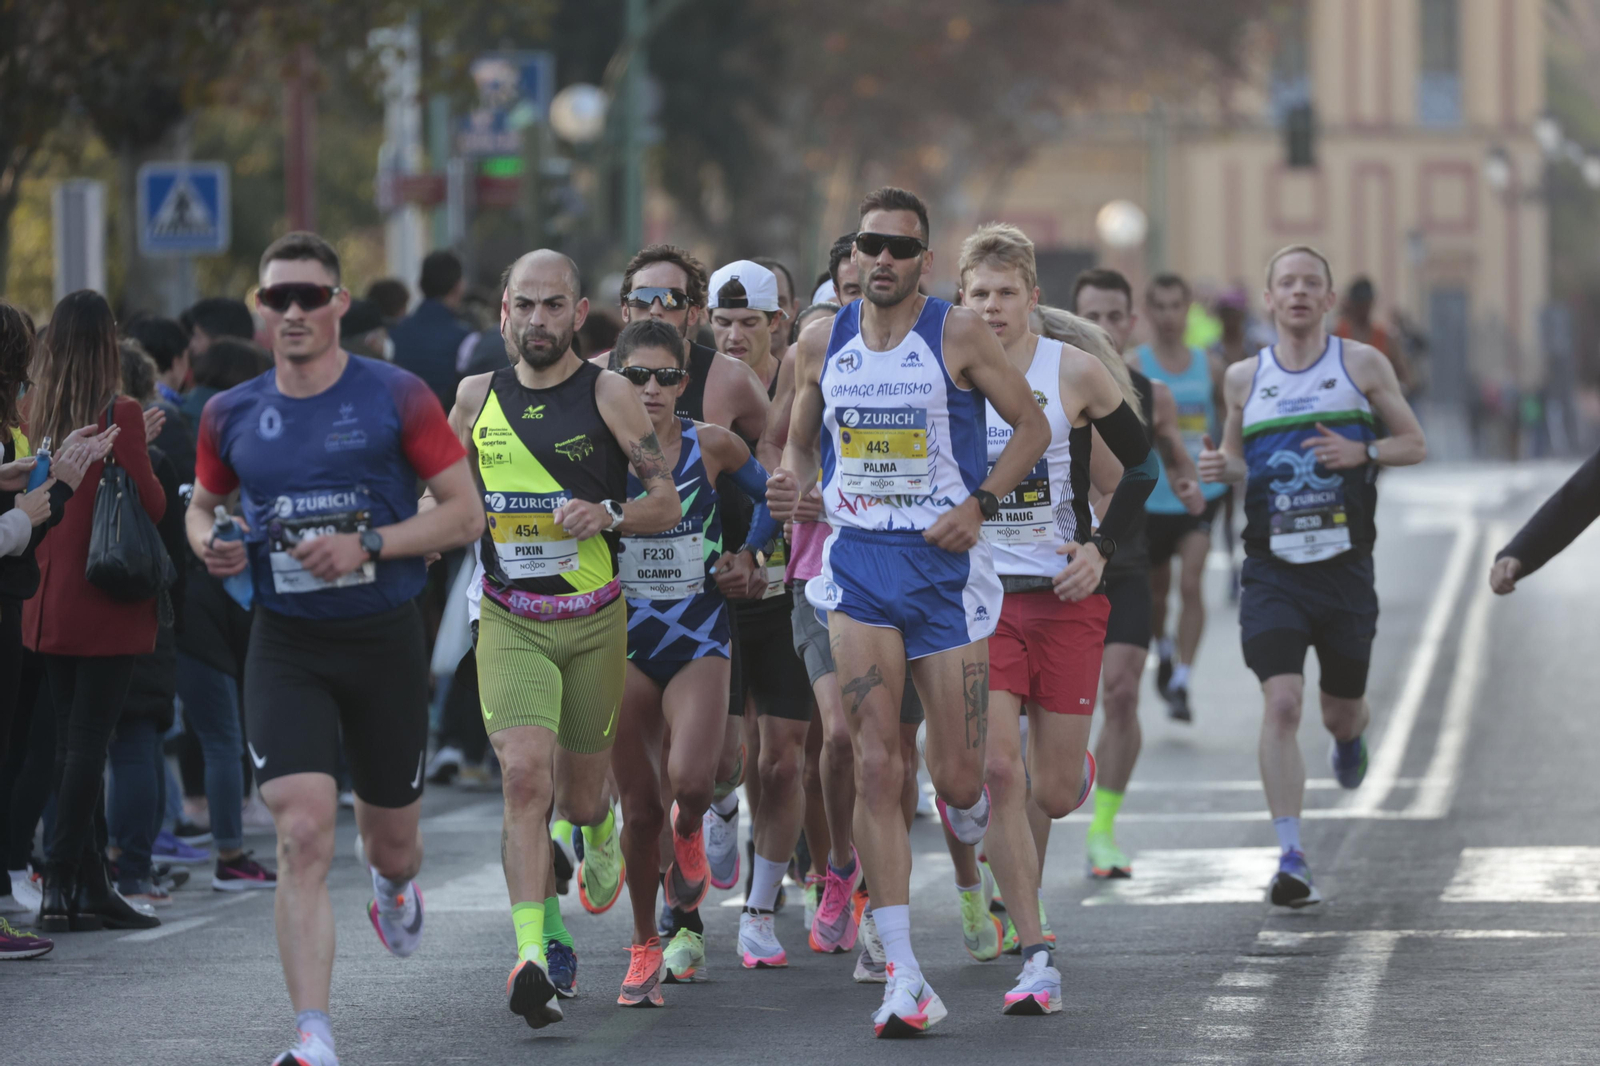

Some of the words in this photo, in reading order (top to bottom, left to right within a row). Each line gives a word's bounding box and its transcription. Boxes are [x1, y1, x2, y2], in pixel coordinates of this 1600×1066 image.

[831, 384, 874, 398] CAMAGC
[876, 382, 932, 396] ATLETISMO
[862, 413, 914, 424] ZURICH
[867, 440, 889, 453] 443
[864, 462, 897, 473] PALMA
[296, 492, 356, 511] ZURICH
[509, 497, 560, 510] ZURICH
[1006, 511, 1033, 522] HAUG
[515, 524, 539, 537] 454
[515, 545, 543, 556] PIXIN
[643, 548, 674, 561] F230
[638, 569, 681, 579] OCAMPO
[557, 592, 597, 614] MAX
